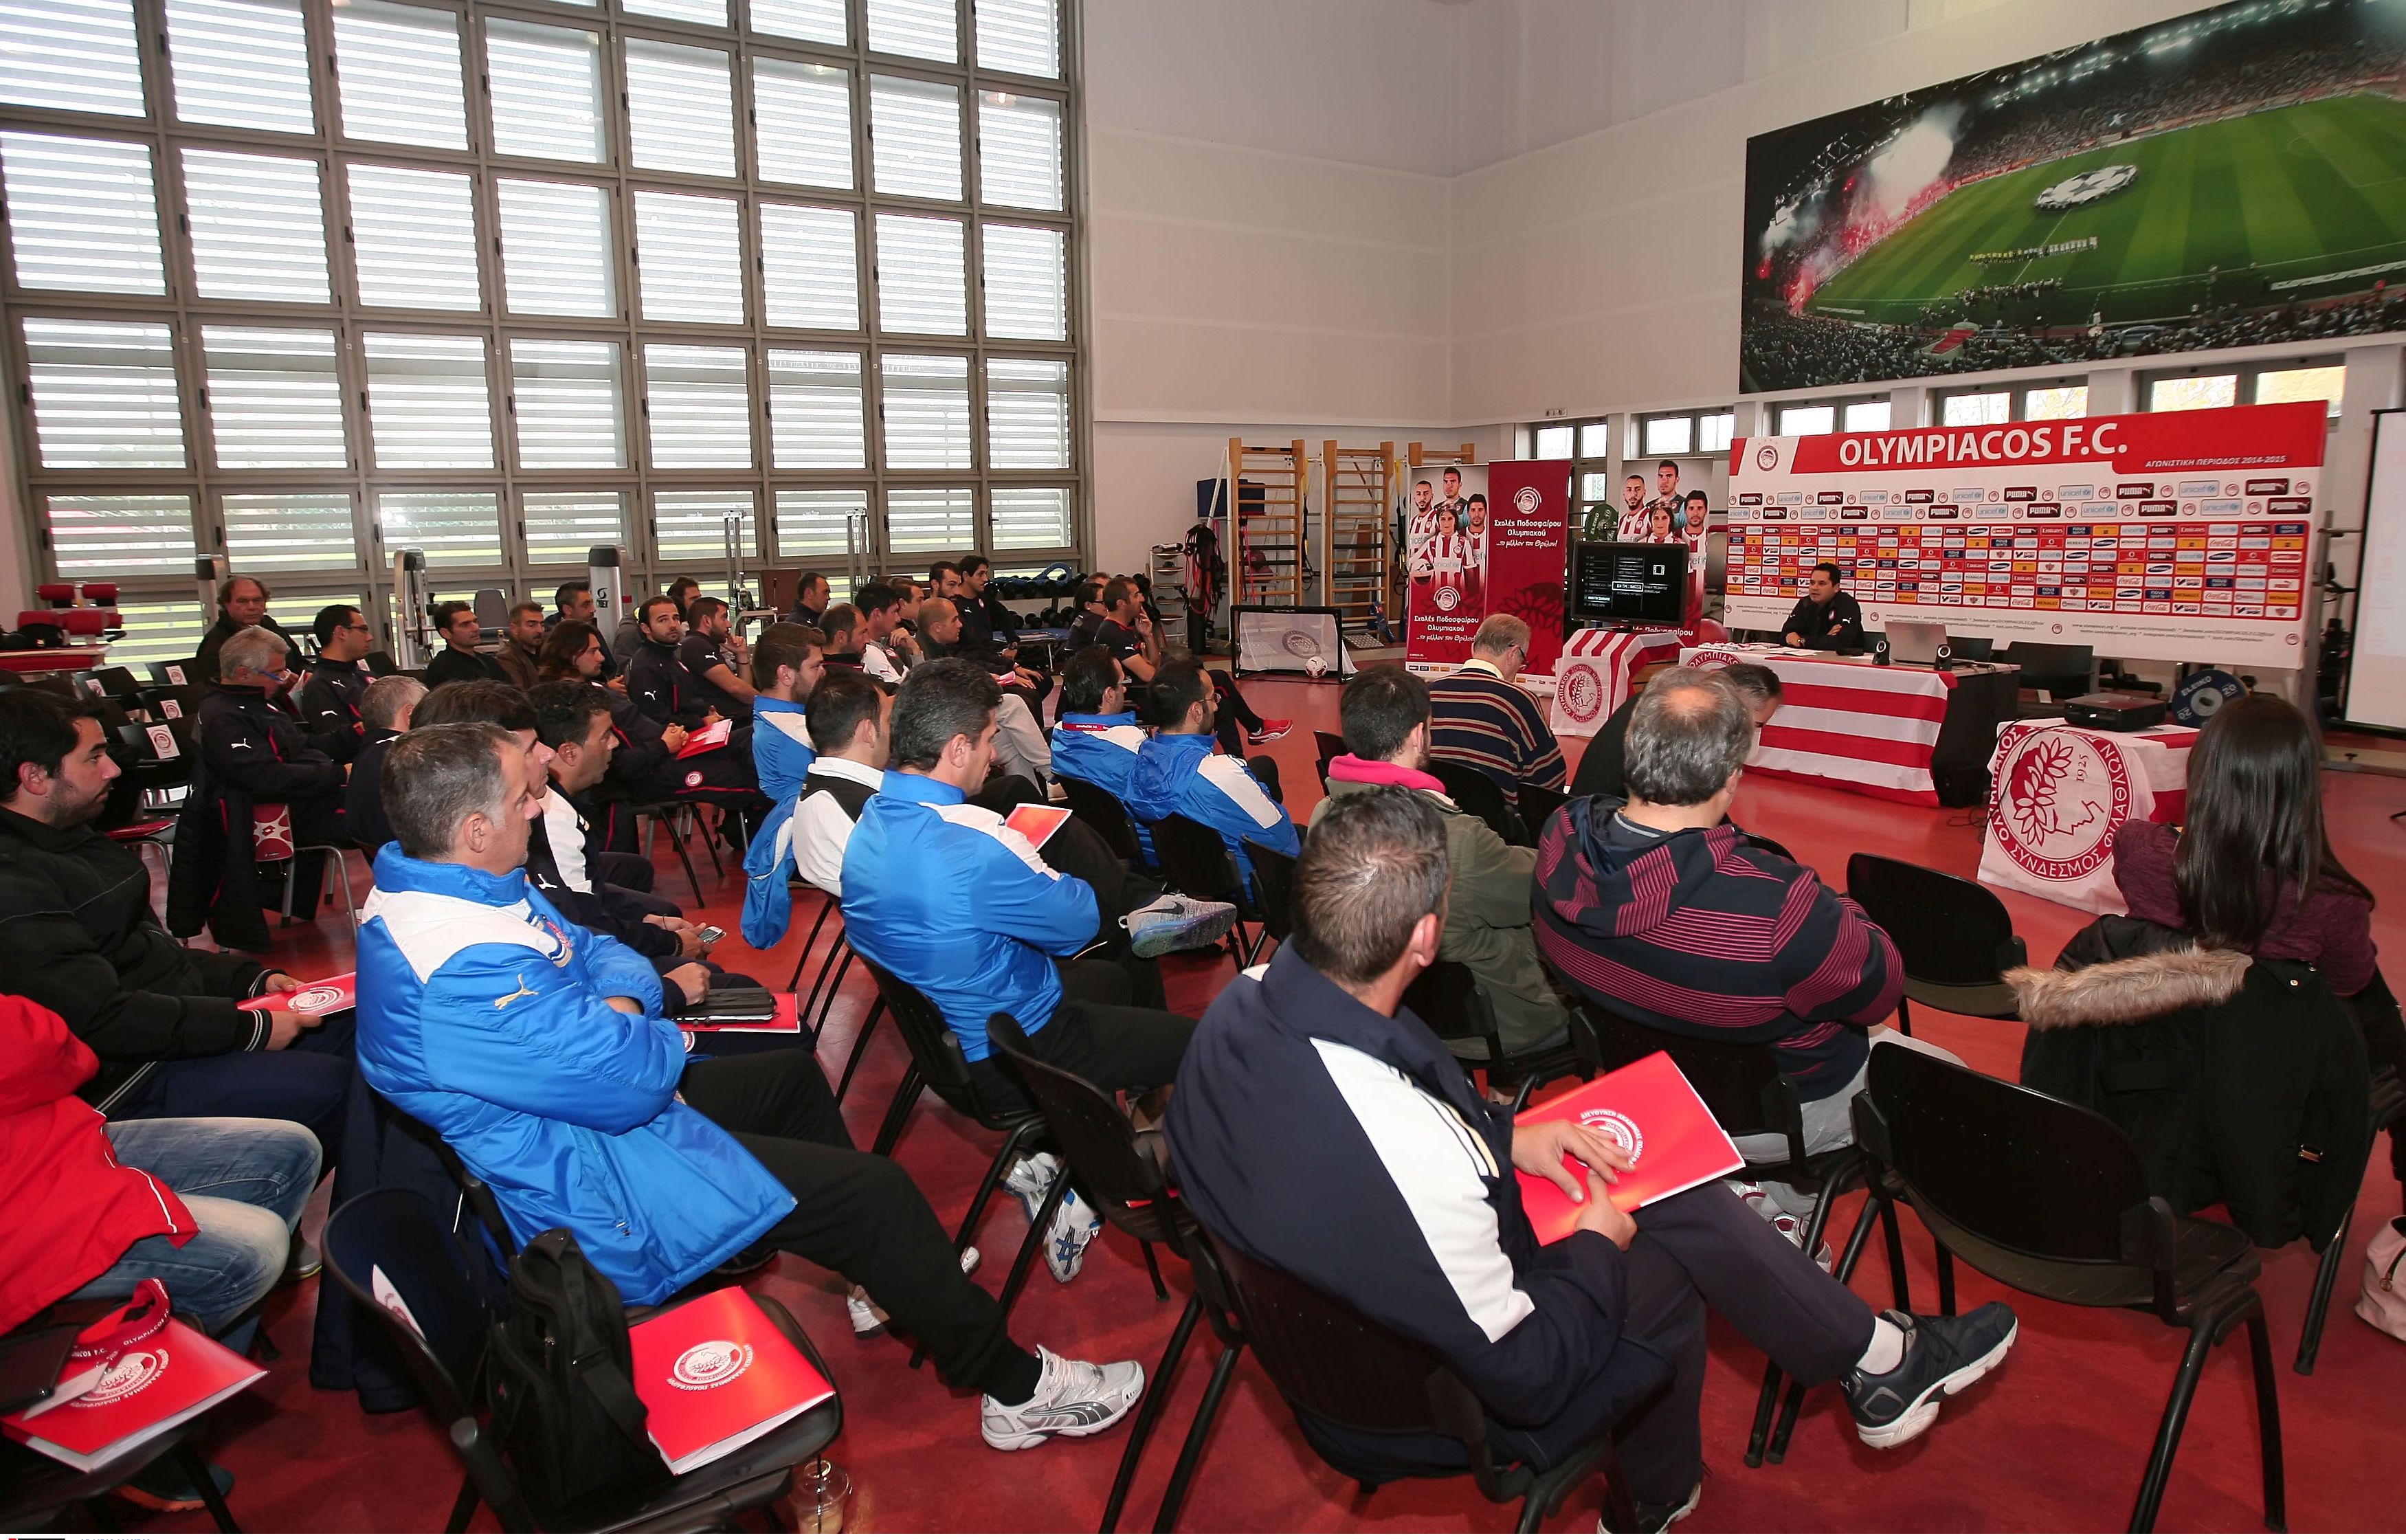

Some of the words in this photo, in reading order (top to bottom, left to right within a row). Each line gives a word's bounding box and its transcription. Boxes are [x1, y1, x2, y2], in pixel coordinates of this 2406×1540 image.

[1839, 427, 2052, 465] OLYMPIACOS
[2062, 423, 2128, 456] F.C.
[2196, 457, 2240, 466] ΠΕΡΙΟΔΟΣ
[2241, 456, 2287, 464] 2014-2015
[2006, 489, 2027, 498] PUMA
[2060, 489, 2082, 497] unicef
[2119, 487, 2143, 495] PUMA
[2029, 506, 2051, 515] PUMA
[2083, 506, 2106, 514] unicef
[2141, 504, 2166, 513] PUMA
[1517, 520, 1561, 528] Ποδοσφαίρου
[1436, 616, 1479, 624] Ποδοσφαίρου
[2181, 676, 2212, 696] ELEIKO
[2222, 684, 2236, 695] 20
[2076, 754, 2088, 783] 1925
[2009, 845, 2104, 878] ΣΥΝΔΕΣΜΟΣ
